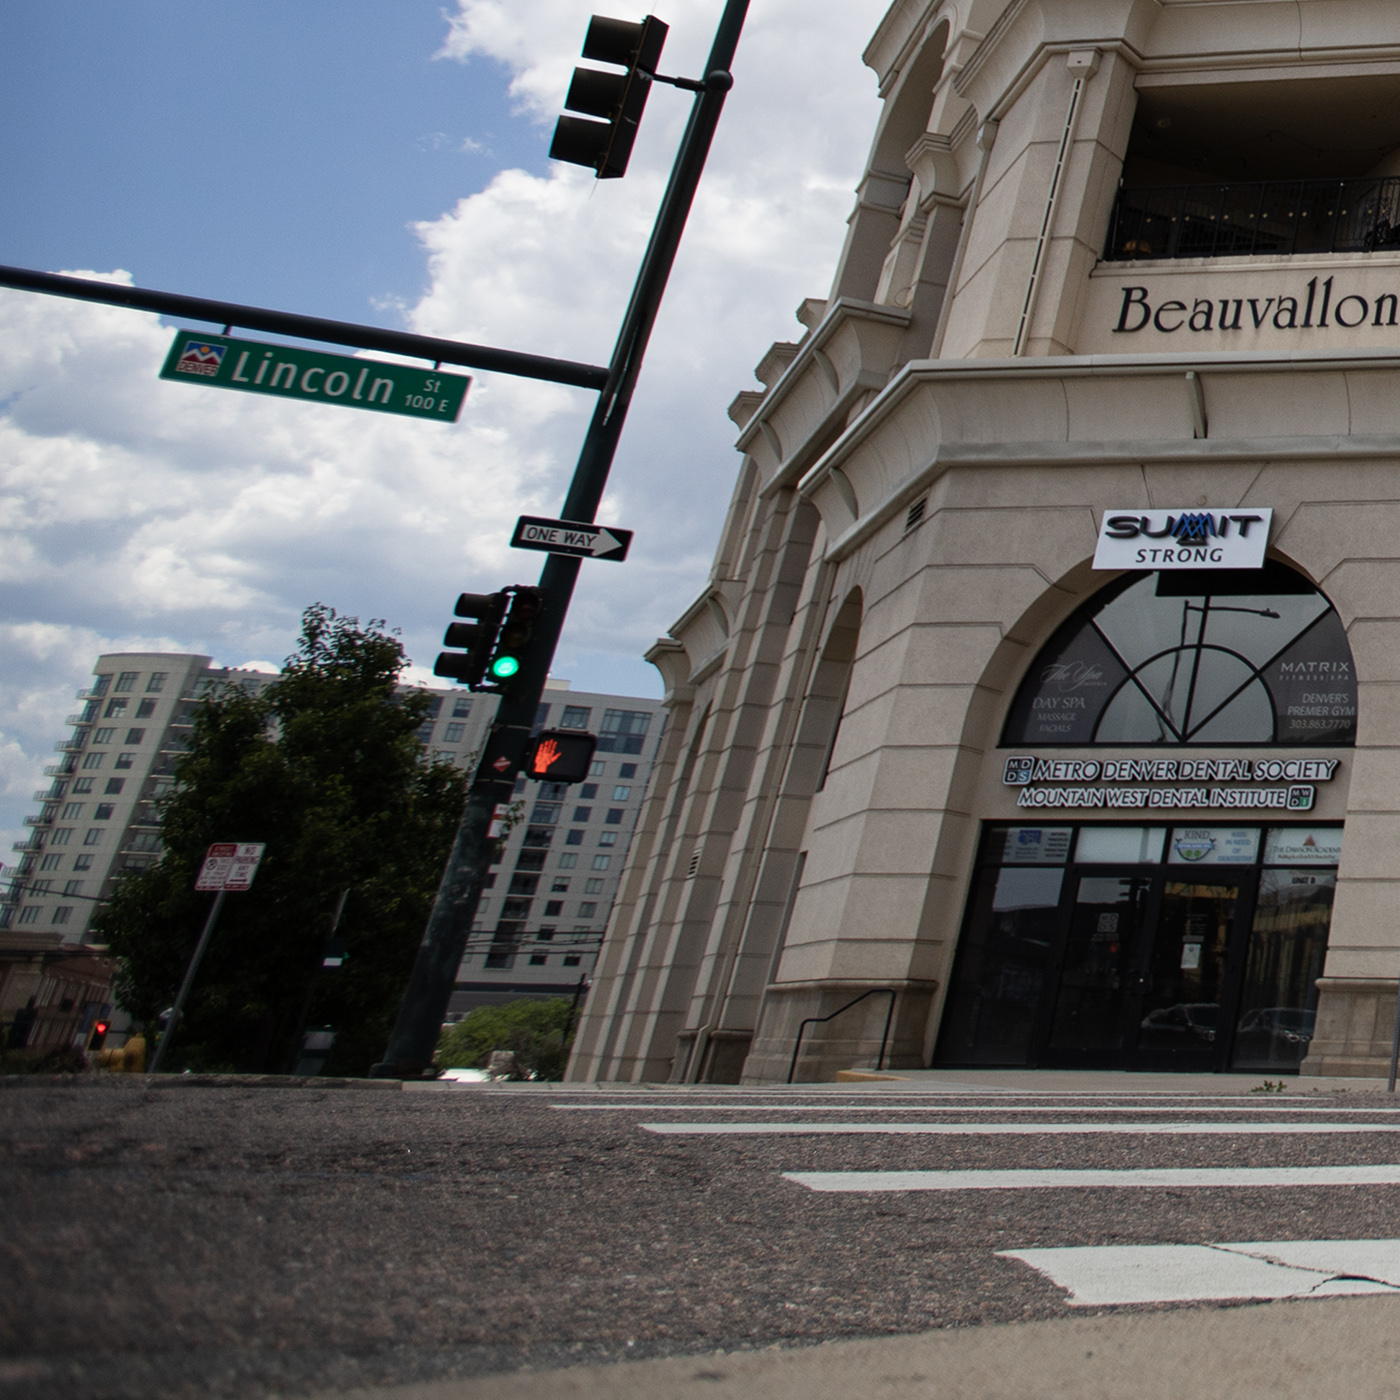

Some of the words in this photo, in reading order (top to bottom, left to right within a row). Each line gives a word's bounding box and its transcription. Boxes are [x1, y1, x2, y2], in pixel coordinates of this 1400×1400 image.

[1112, 275, 1399, 333] Beauvallon
[177, 360, 219, 377] DENVER
[231, 350, 395, 405] Lincoln
[423, 378, 441, 393] St
[404, 393, 434, 411] 100
[437, 398, 450, 413] E
[1105, 512, 1264, 540] SUMMIT
[526, 526, 559, 542] ONE
[563, 531, 597, 547] WAY
[1135, 547, 1224, 563] STRONG
[1280, 661, 1349, 672] MATRIX
[1032, 696, 1060, 709] DAY
[1061, 696, 1086, 709] SPA
[1302, 692, 1349, 704] DENVER'S
[1037, 712, 1077, 721] MASSAGE
[1287, 705, 1330, 717] PREMIER
[1331, 705, 1355, 717] GYM
[1033, 760, 1100, 780] METRO
[1101, 760, 1178, 780] DENVER
[1178, 760, 1251, 780] DENTAL
[1253, 759, 1338, 781] SOCIETY
[1018, 788, 1105, 806] MOUNTAIN
[1106, 788, 1148, 806] WEST
[1149, 788, 1209, 806] DENTAL
[1210, 788, 1285, 806] INSTITUTE
[1183, 829, 1211, 840] KIND
[1291, 876, 1309, 884] UNIT
